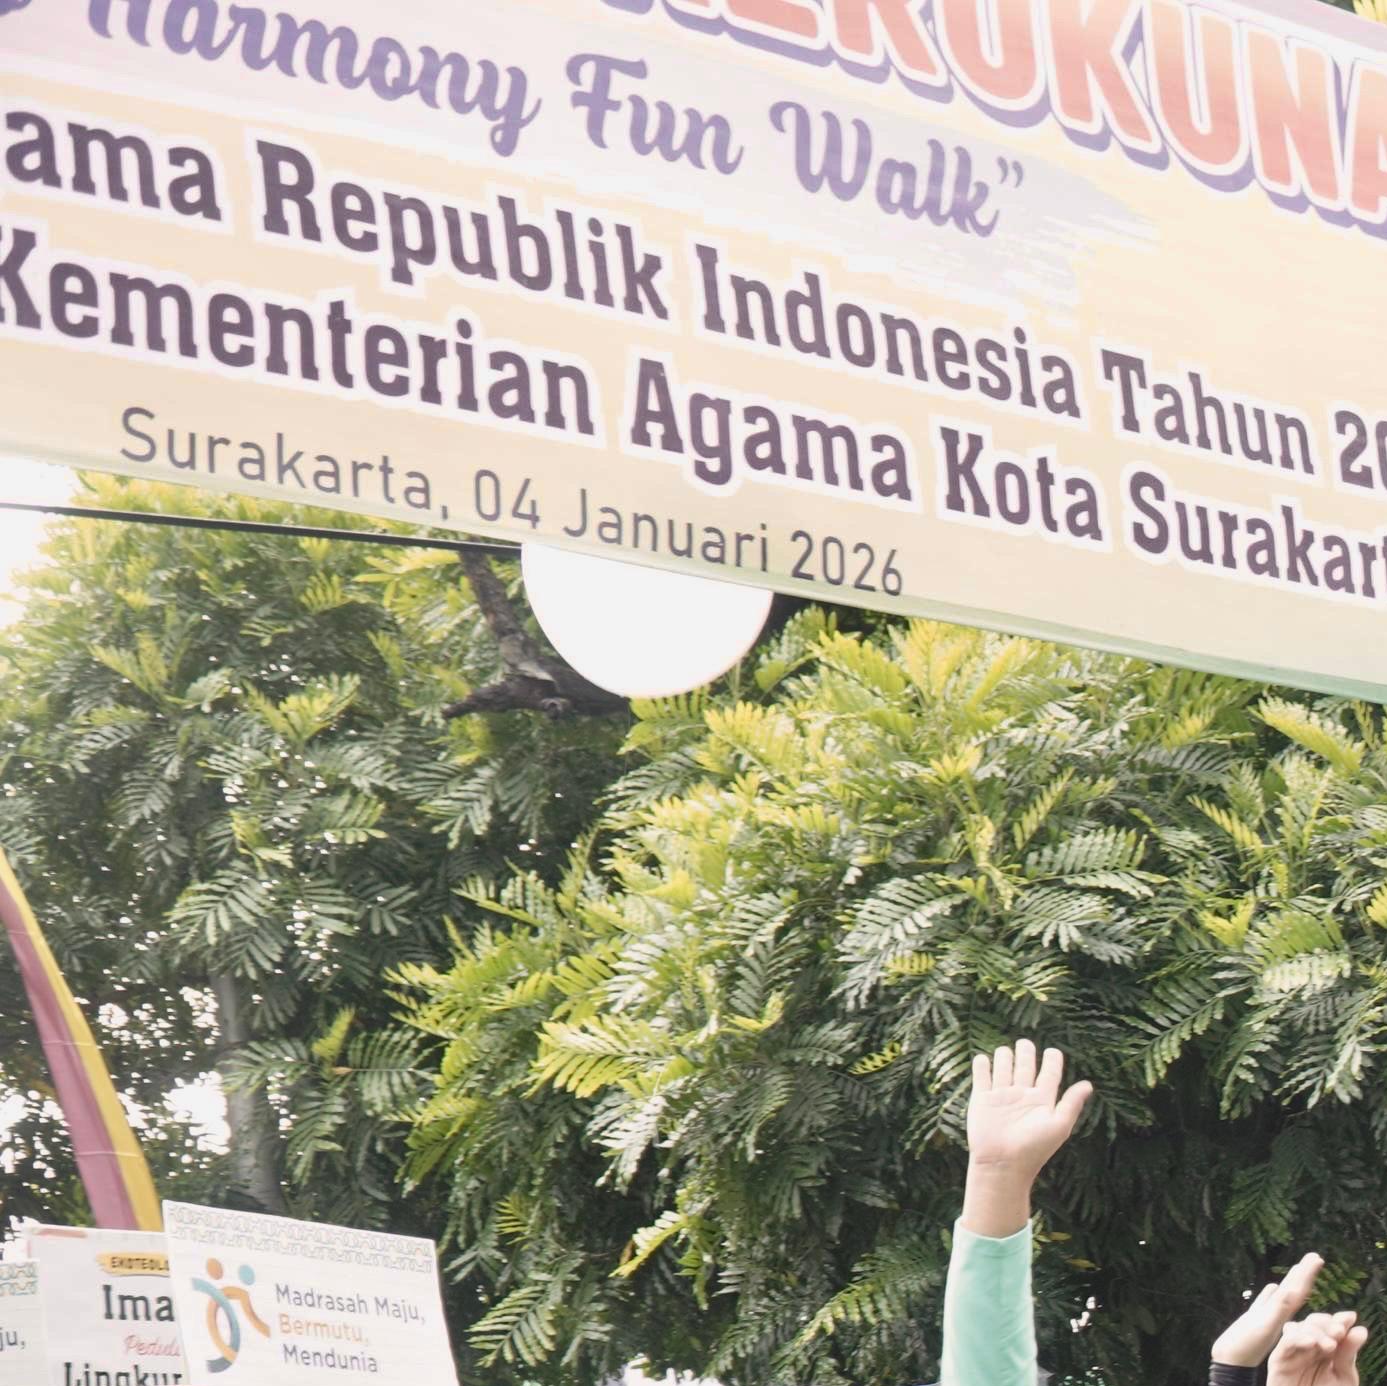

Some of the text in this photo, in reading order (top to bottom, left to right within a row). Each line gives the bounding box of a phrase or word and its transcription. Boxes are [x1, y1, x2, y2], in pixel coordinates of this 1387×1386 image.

[565, 53, 744, 175] Fun
[0, 225, 596, 436] Kementerian
[630, 358, 913, 502] Agama
[939, 426, 1103, 542] Kota
[255, 139, 671, 321] Republik
[695, 244, 1083, 419] Indonesia
[1101, 348, 1316, 476] Tahun
[119, 407, 905, 597] Surakarta, 04 Januari 2026
[275, 1283, 426, 1325] Madrasah Maju,
[282, 1343, 379, 1373] Mendunia
